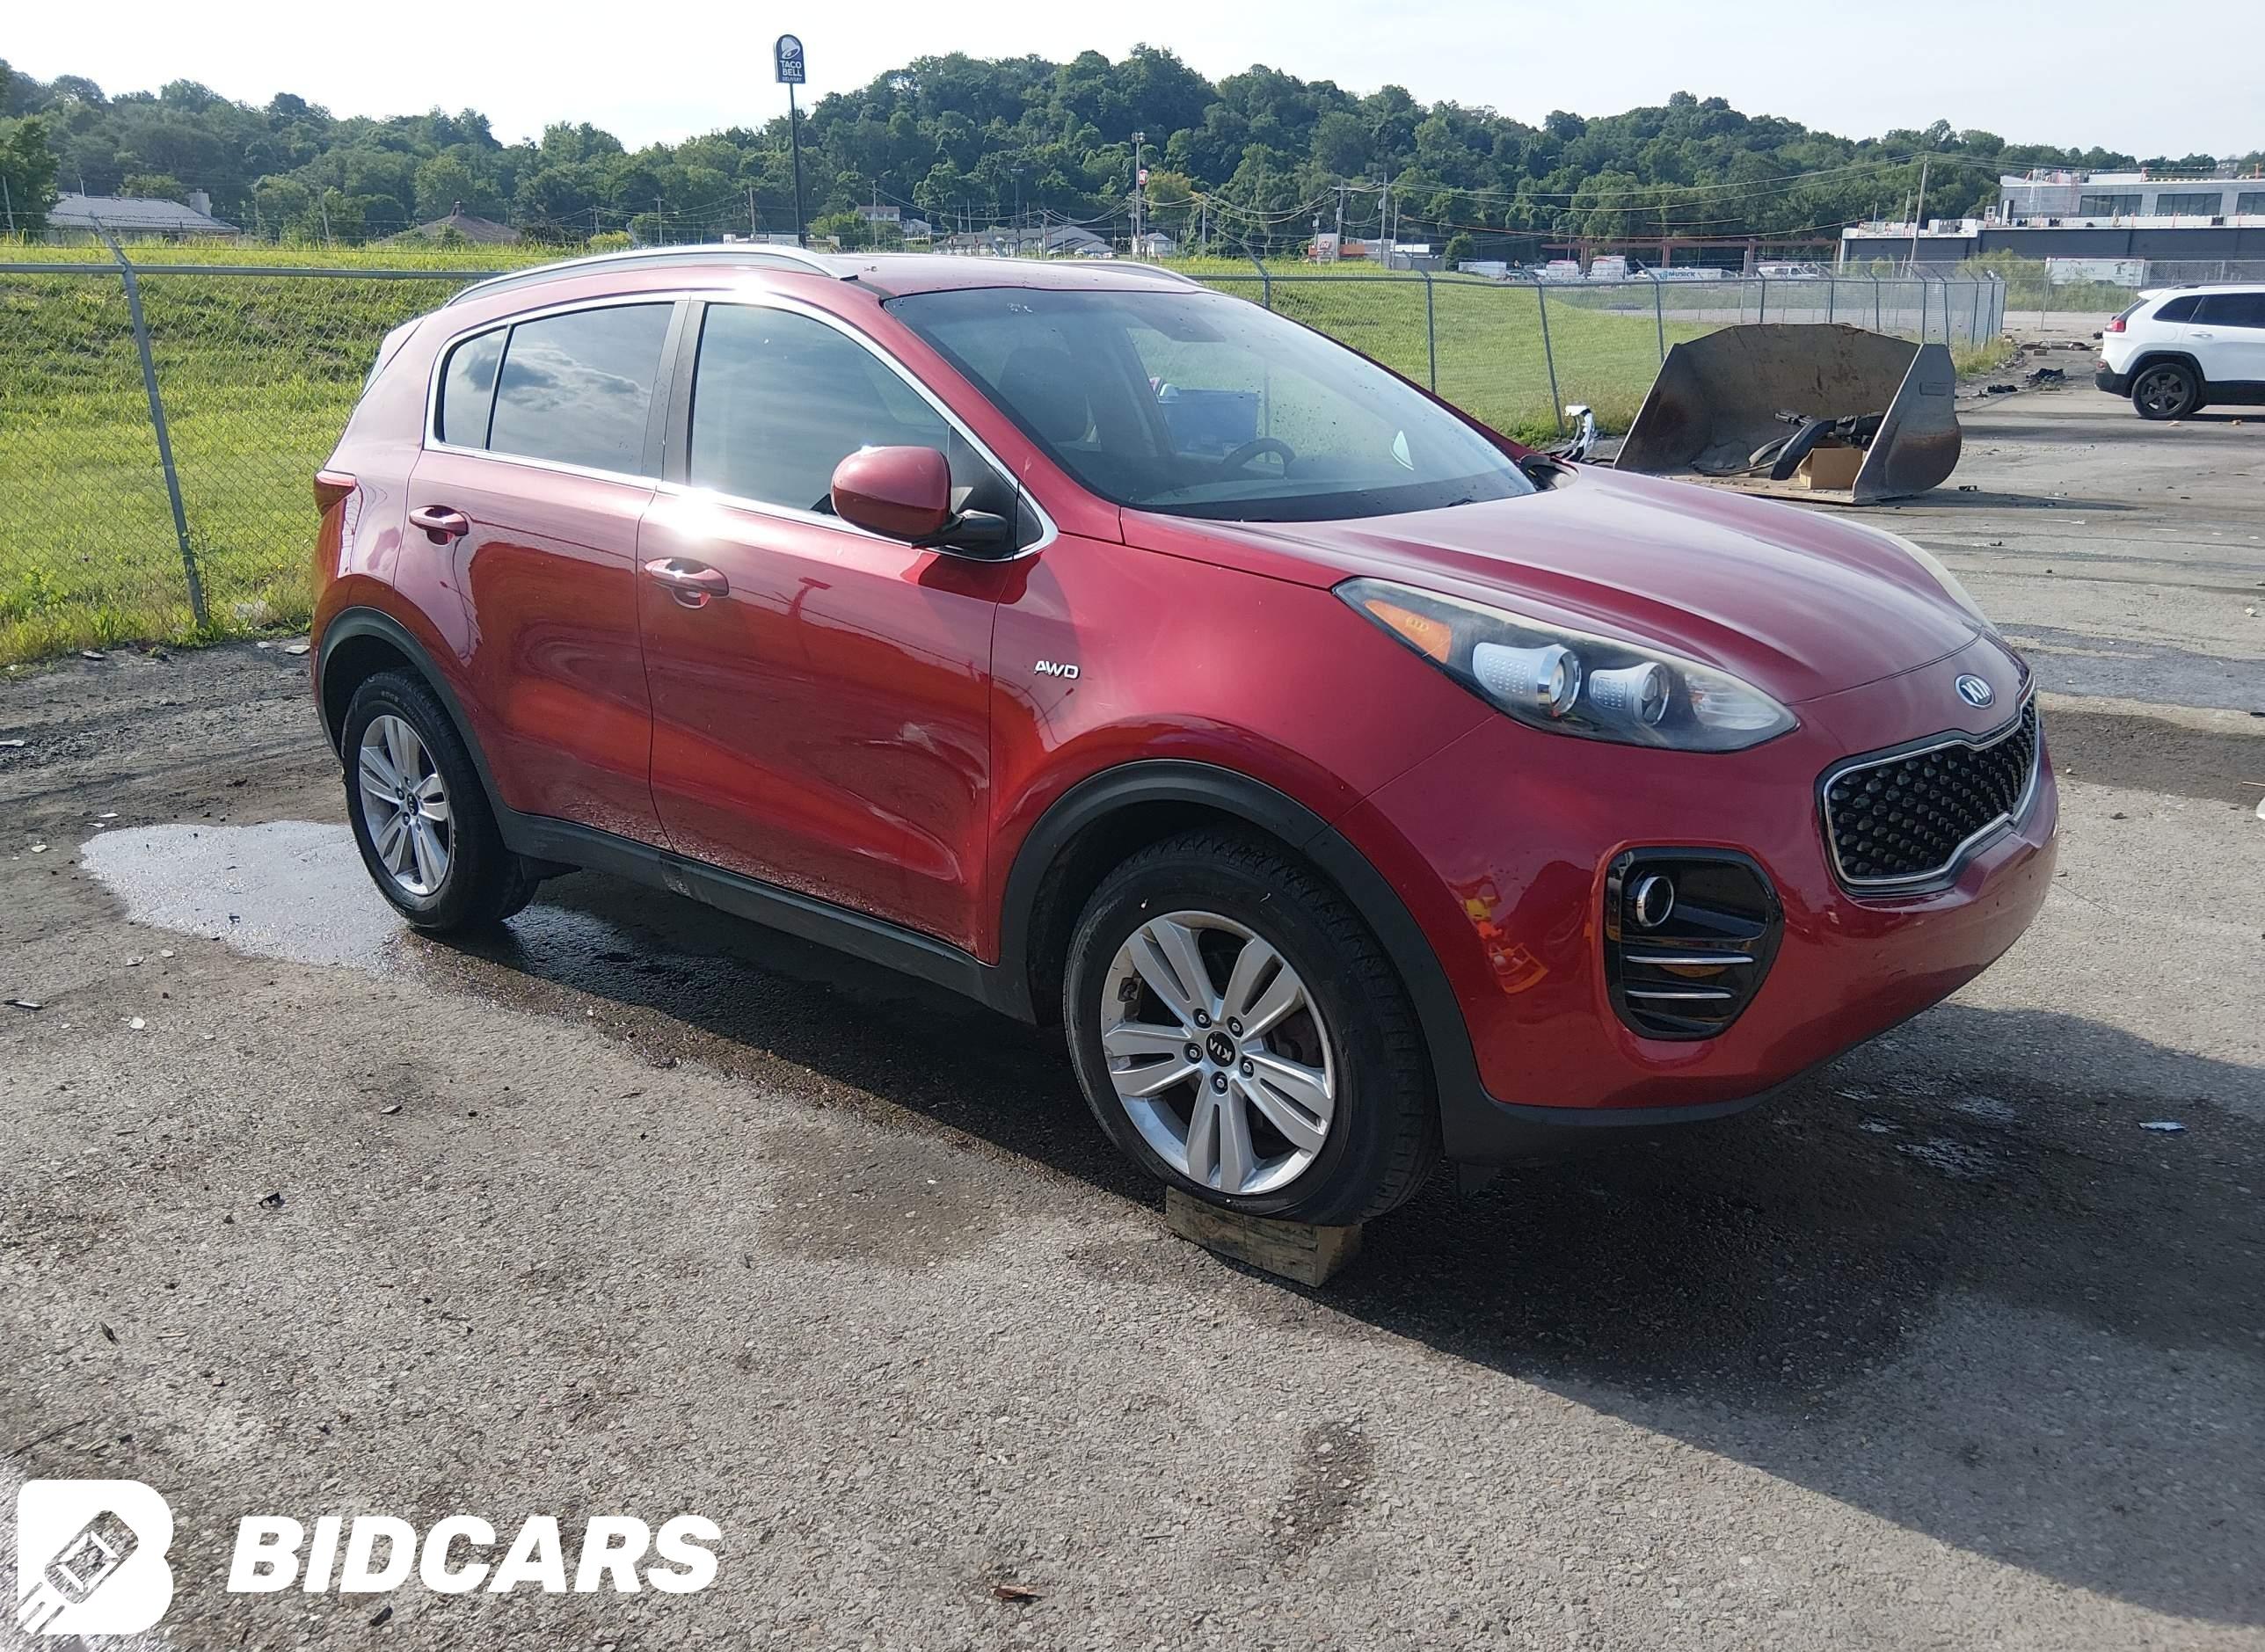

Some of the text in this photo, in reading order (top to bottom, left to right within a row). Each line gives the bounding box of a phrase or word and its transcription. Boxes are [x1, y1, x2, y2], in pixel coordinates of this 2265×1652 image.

[779, 60, 802, 69] TACO
[1034, 660, 1079, 680] AWD
[1210, 1038, 1232, 1061] KIA
